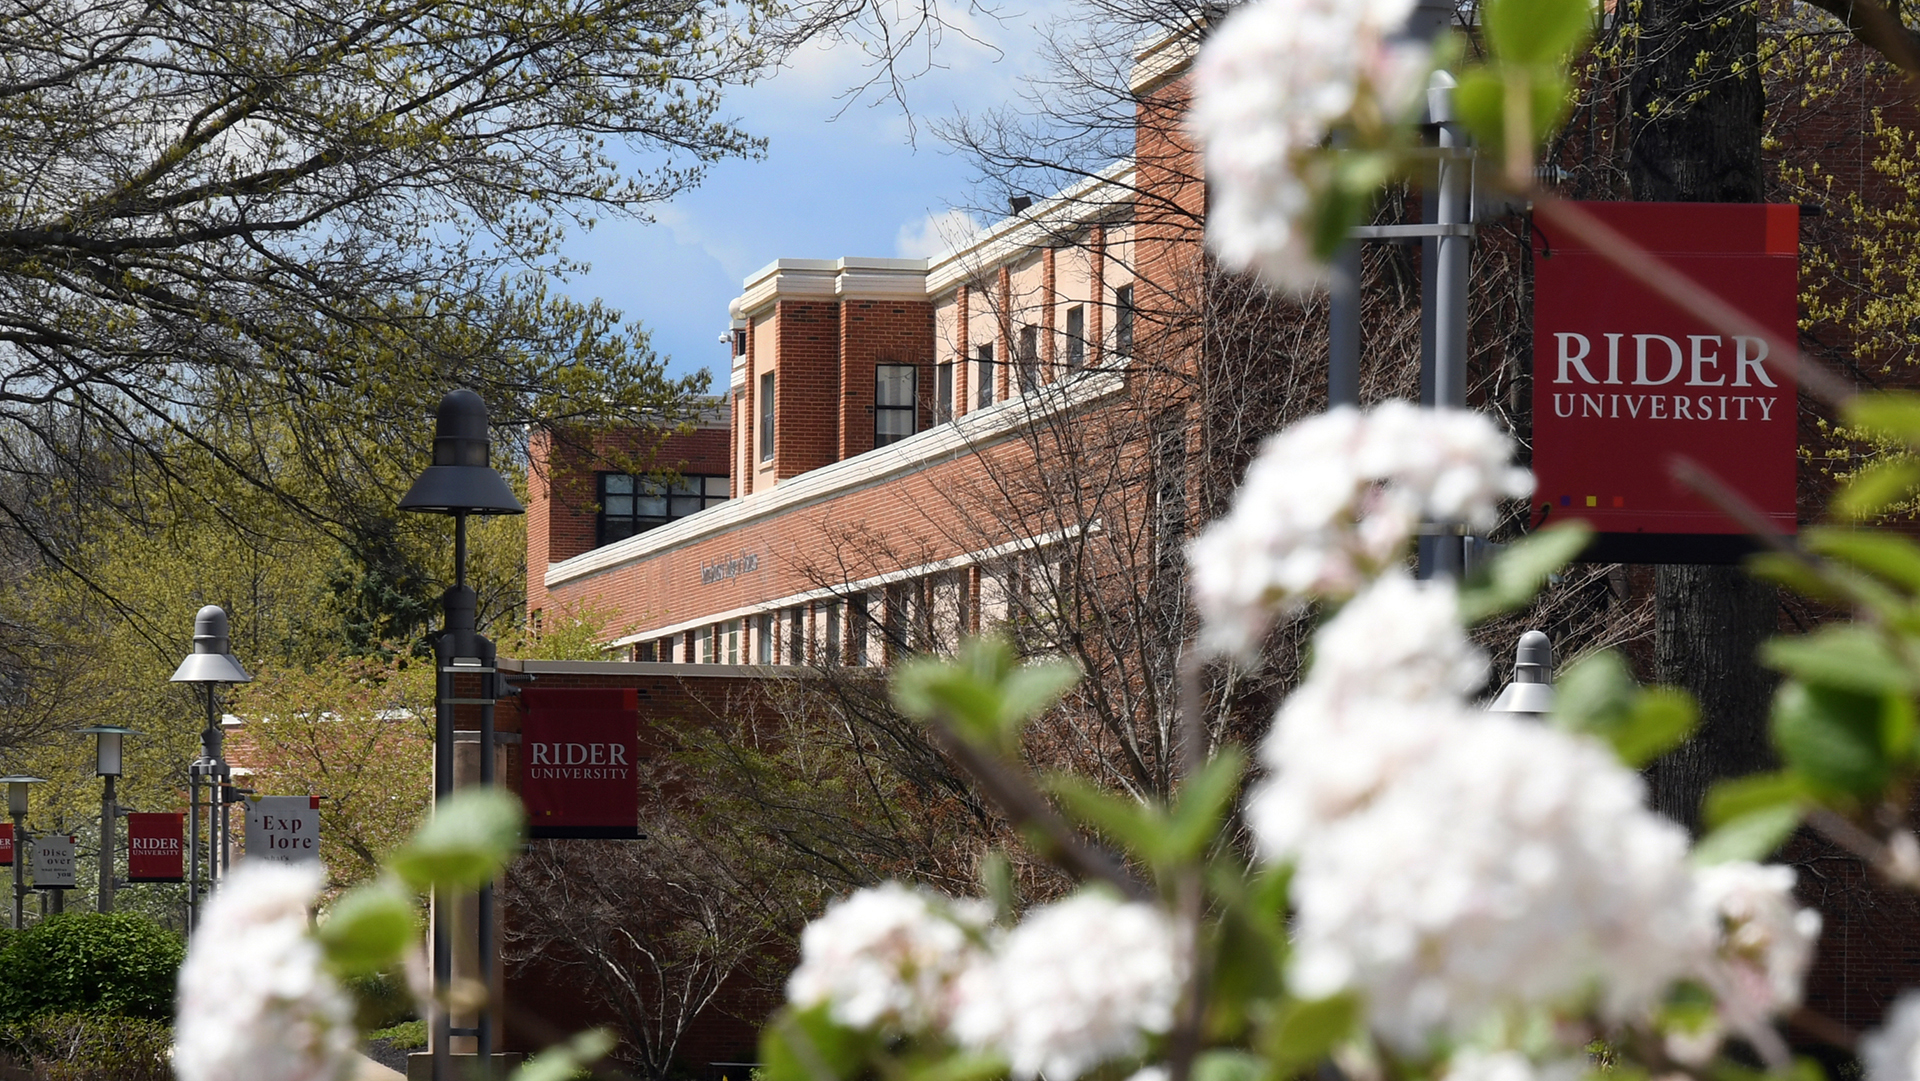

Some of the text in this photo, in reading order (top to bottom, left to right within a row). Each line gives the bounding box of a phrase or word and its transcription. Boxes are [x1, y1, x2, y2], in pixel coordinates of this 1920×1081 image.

[1552, 332, 1778, 388] RIDER
[1553, 393, 1778, 421] UNIVERSITY
[530, 742, 629, 766] RIDER
[531, 768, 629, 779] UNIVERSITY
[263, 815, 302, 834] Exp
[132, 837, 179, 849] RIDER
[270, 834, 312, 849] lore
[43, 848, 67, 857] Disc
